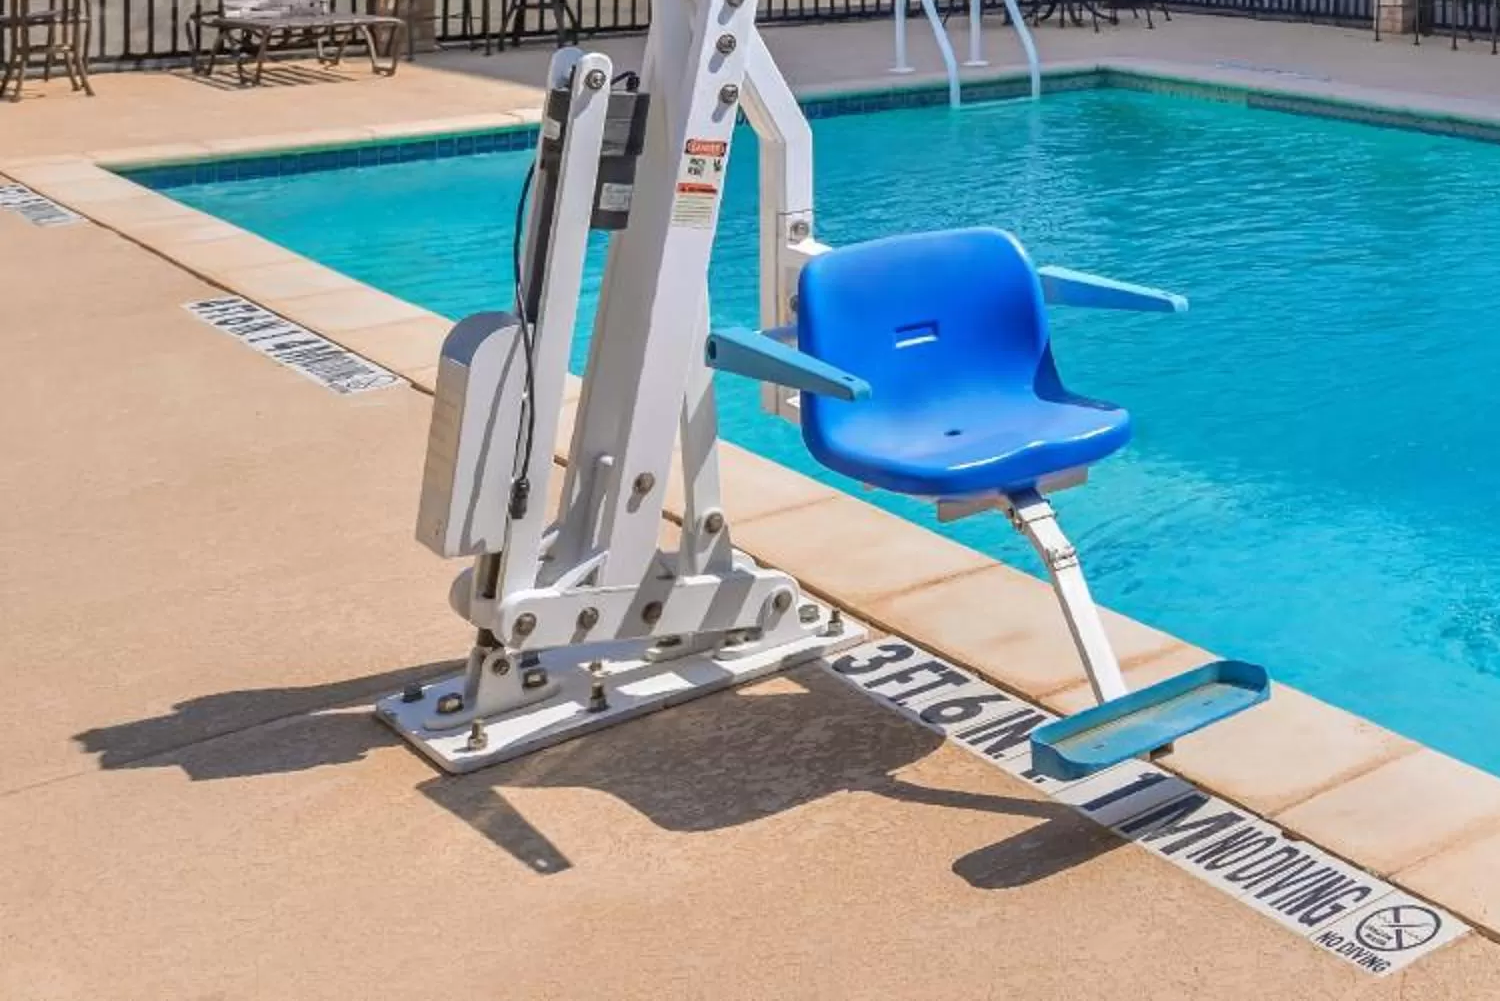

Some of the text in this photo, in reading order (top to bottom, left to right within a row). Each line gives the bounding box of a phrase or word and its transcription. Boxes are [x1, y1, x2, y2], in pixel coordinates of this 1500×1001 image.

[832, 644, 914, 676] 3
[919, 694, 1011, 724] 6
[1081, 772, 1170, 812] 1
[1119, 793, 1247, 856] M
[1185, 826, 1277, 871] NO
[1224, 845, 1373, 927] DIVING
[1316, 930, 1392, 973] NO DIVING
